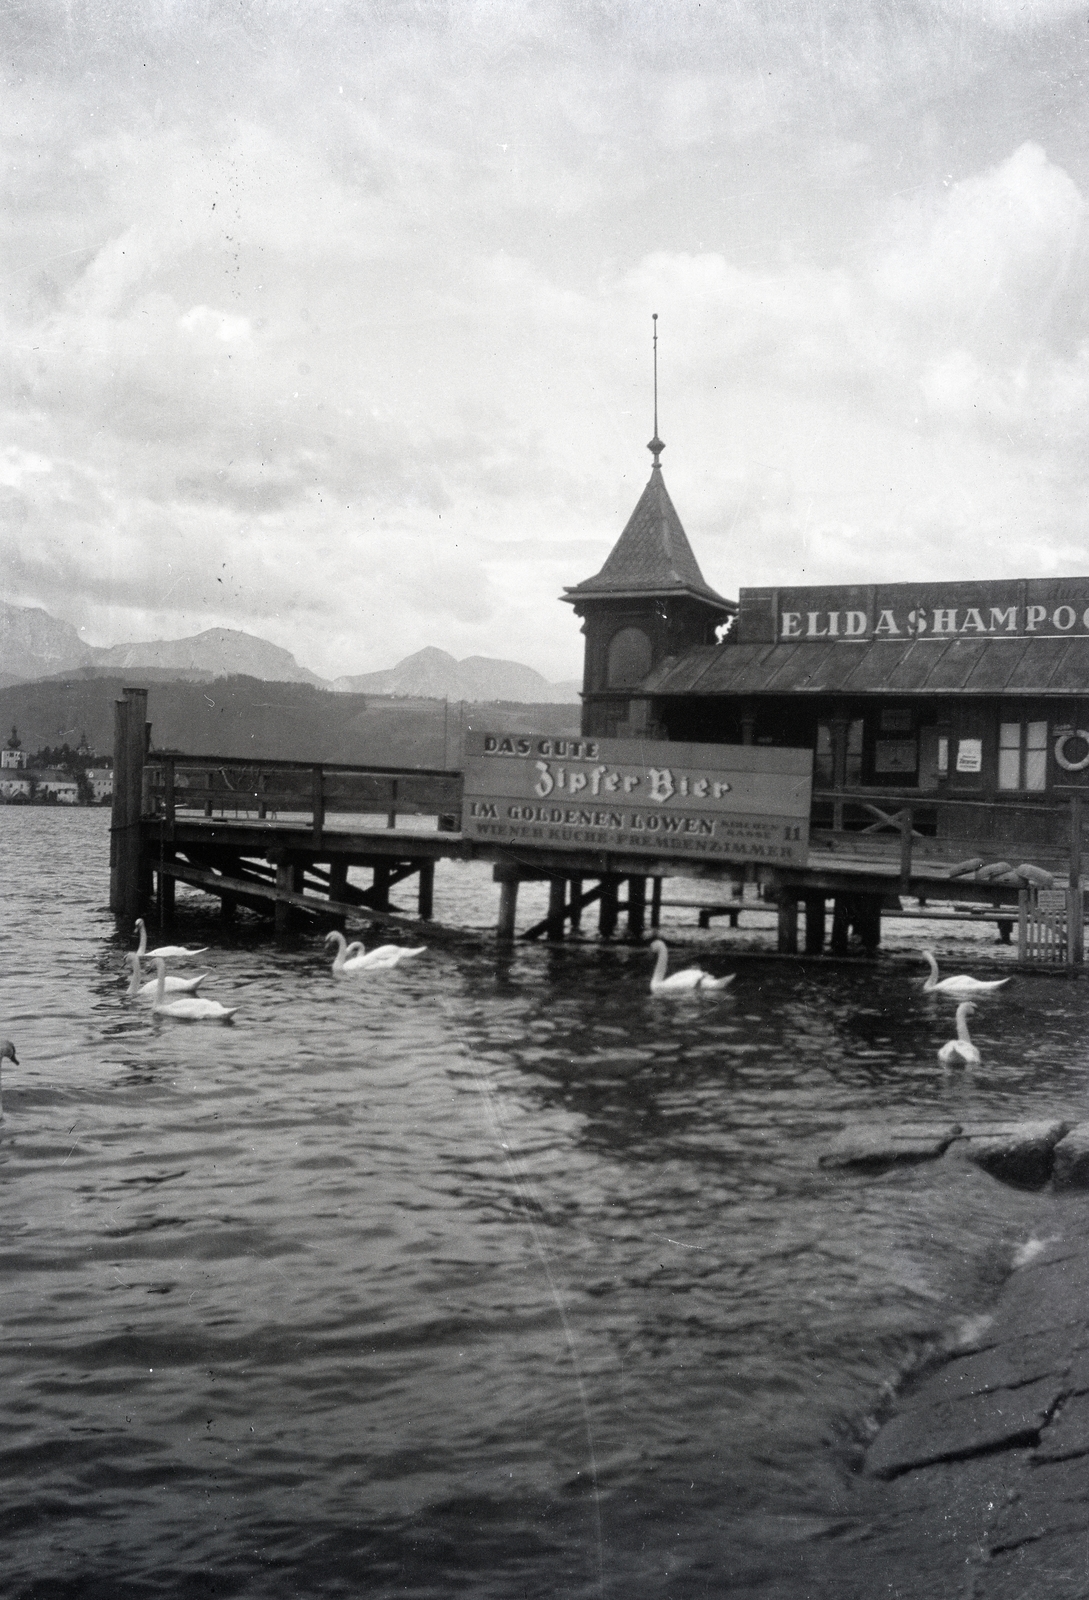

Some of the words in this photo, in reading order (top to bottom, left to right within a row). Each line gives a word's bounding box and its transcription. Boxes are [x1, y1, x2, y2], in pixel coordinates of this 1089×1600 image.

[781, 610, 900, 637] ELIDA
[908, 603, 1089, 634] SHAMPO
[485, 737, 531, 757] DAS
[537, 740, 600, 761] GUTE
[535, 760, 639, 798] Zipfer
[649, 768, 732, 803] Bier
[471, 802, 500, 820] IM
[507, 806, 626, 830] GOLDENEN
[631, 811, 716, 836] LÖWEN
[476, 823, 544, 839] WIENER
[616, 834, 793, 859] FREMDENZIMMER
